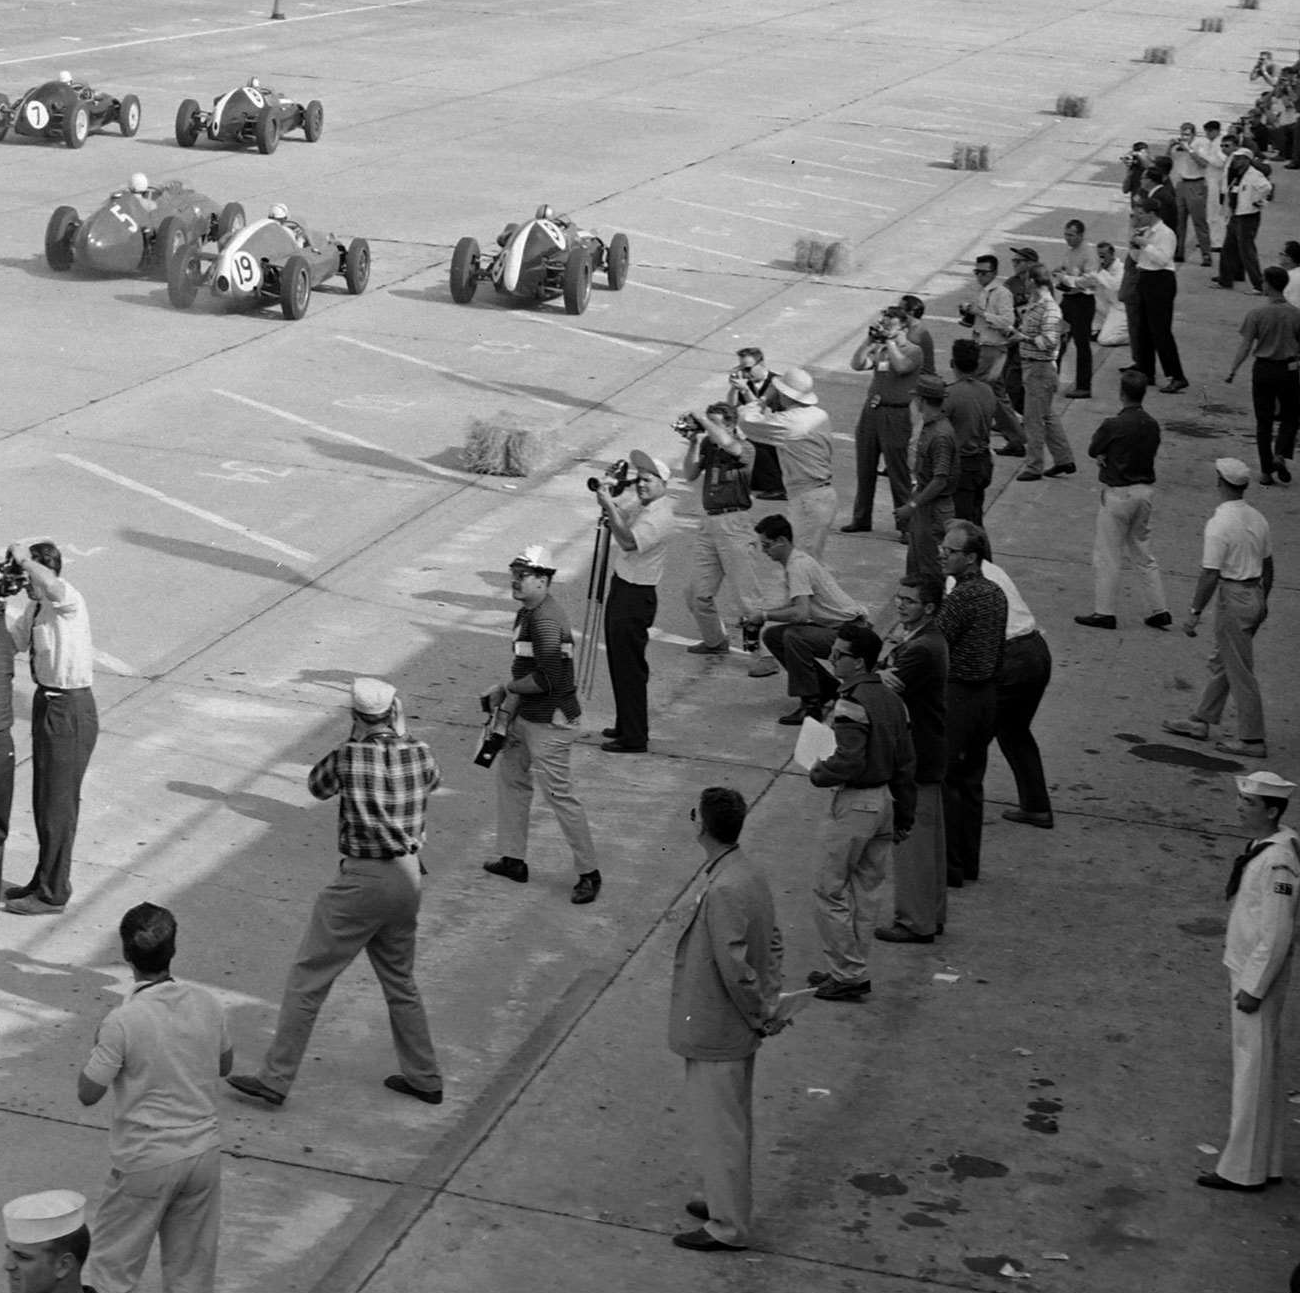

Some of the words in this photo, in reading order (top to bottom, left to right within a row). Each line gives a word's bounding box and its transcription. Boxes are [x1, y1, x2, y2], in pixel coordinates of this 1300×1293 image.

[31, 106, 42, 126] 7
[109, 205, 138, 232] 5
[235, 256, 257, 285] 19
